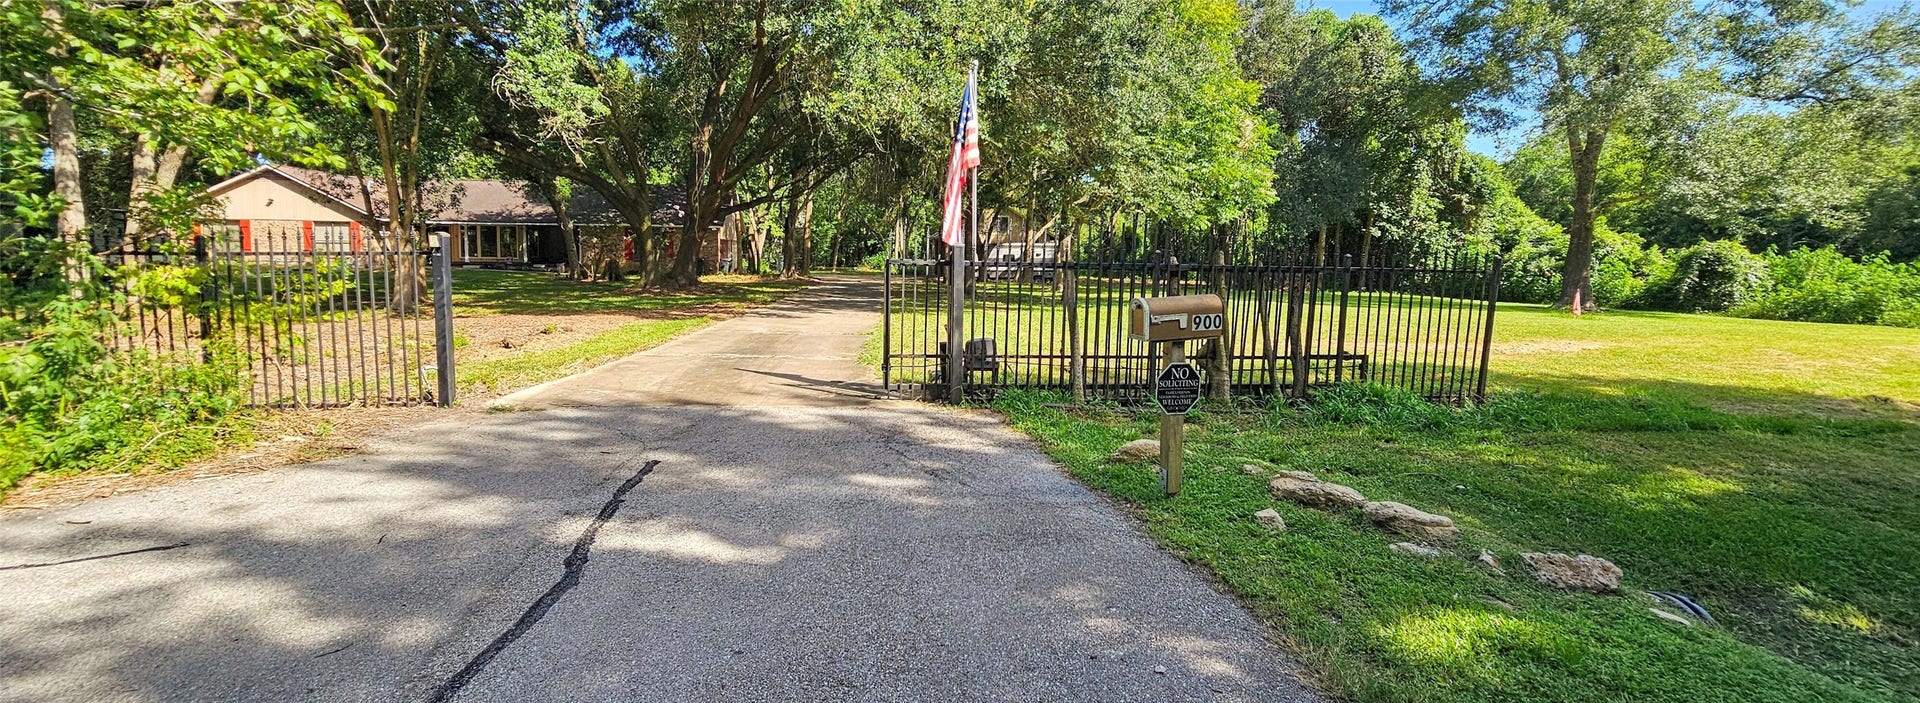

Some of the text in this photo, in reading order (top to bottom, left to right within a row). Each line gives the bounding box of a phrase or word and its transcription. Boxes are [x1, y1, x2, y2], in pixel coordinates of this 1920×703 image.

[1193, 315, 1222, 329] 900
[1171, 367, 1189, 379] NO
[1159, 379, 1198, 387] SOLICITING
